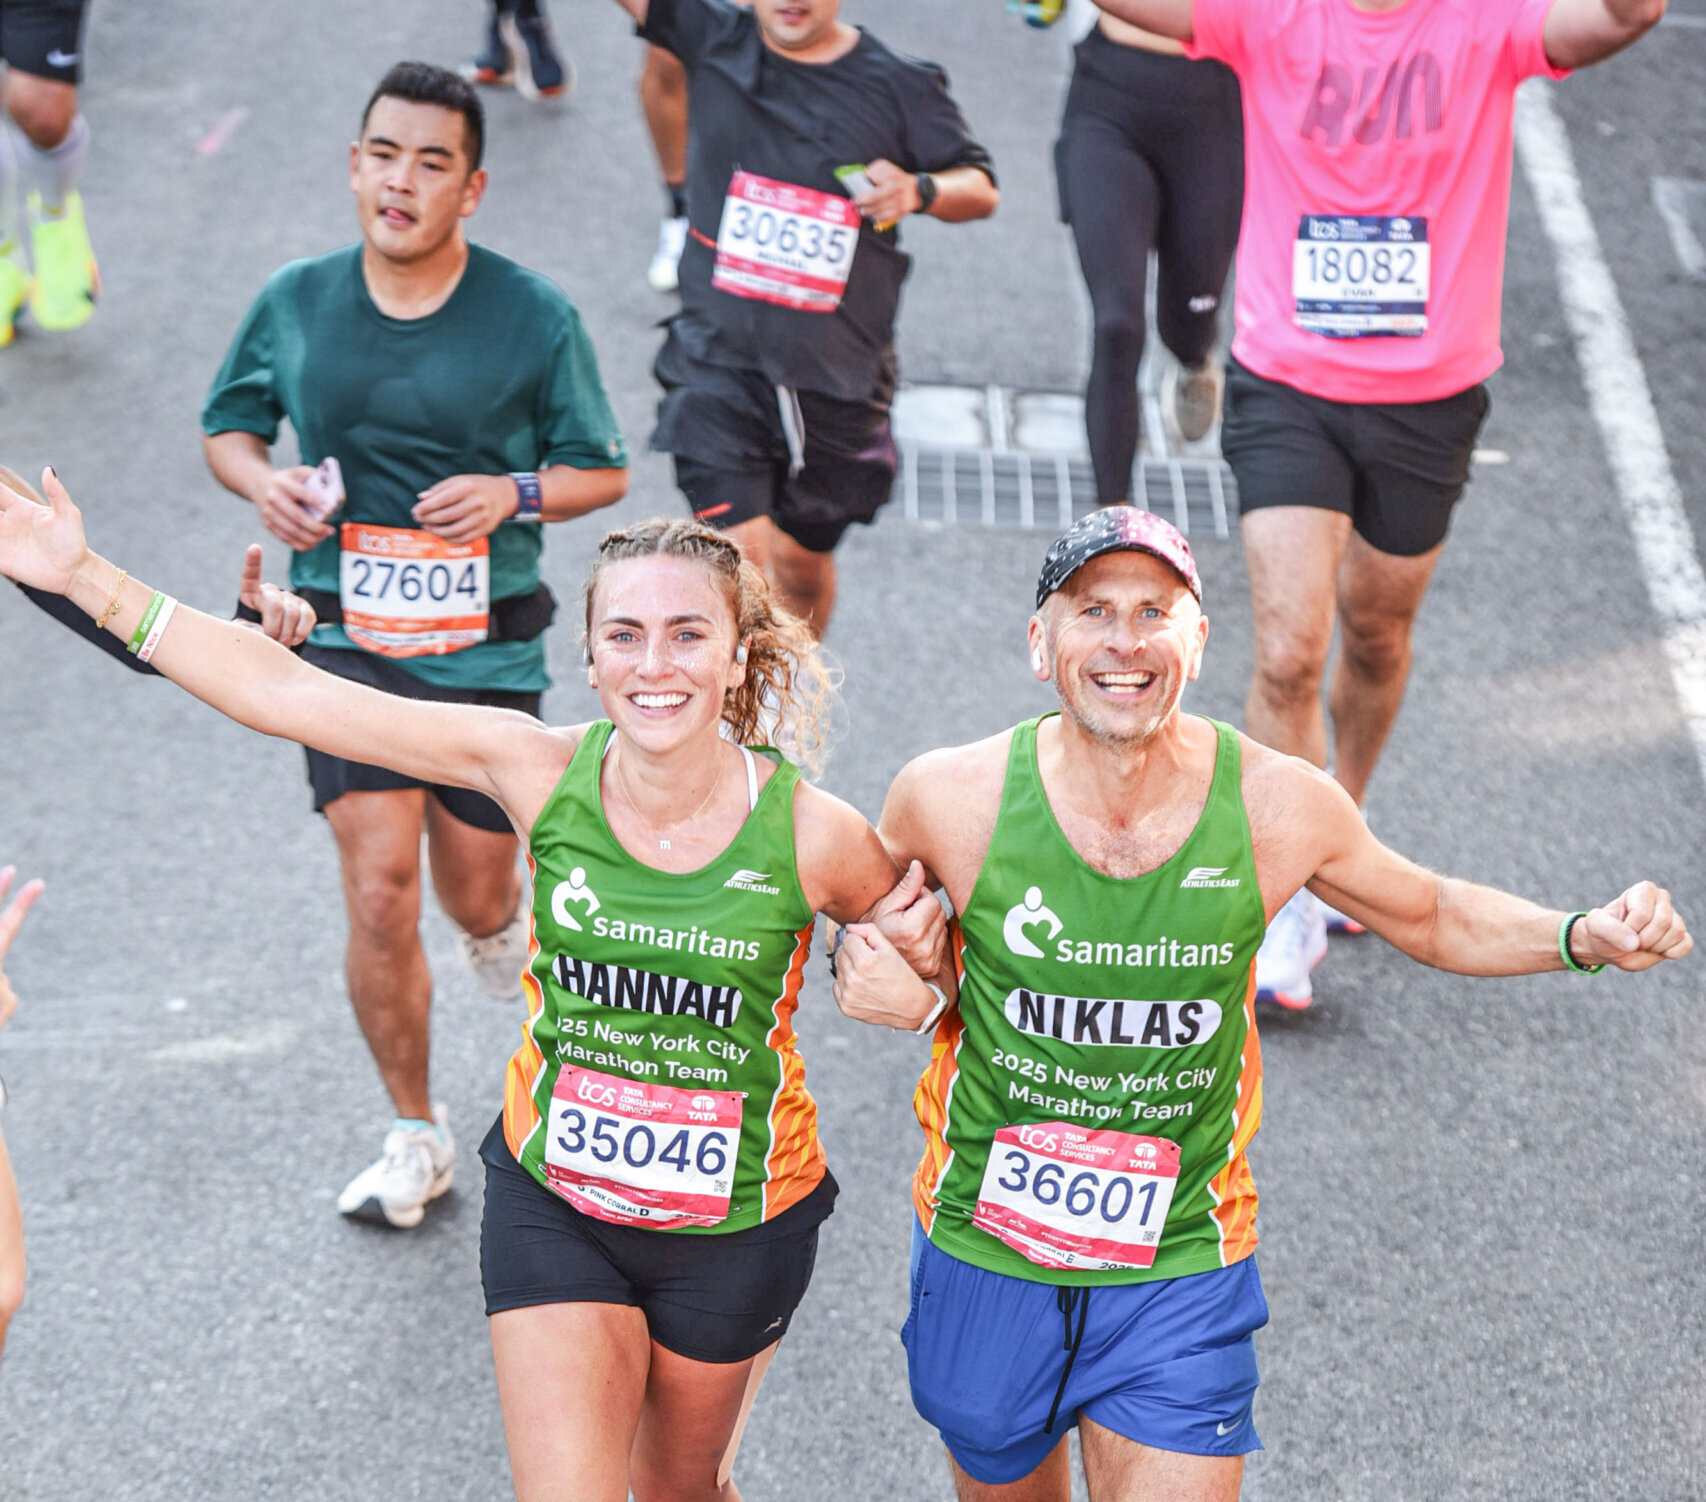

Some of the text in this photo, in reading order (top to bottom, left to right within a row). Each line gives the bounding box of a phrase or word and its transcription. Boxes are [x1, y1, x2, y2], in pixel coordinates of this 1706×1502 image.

[1300, 50, 1442, 146] RUN
[730, 205, 848, 264] 30635
[1308, 247, 1416, 284] 18082
[353, 559, 478, 601] 27604
[592, 916, 761, 961] samaritans
[1056, 936, 1234, 967] samaritans
[558, 952, 740, 1028] HANNAH
[1017, 989, 1203, 1047] NIKLAS
[557, 1015, 751, 1065] 25 New York City
[557, 1040, 728, 1083] Marathon Team
[991, 1048, 1217, 1093] 2025 New York City
[577, 1075, 618, 1107] tcs
[620, 1094, 673, 1110] CONSULTANCY
[623, 1086, 644, 1098] TATA
[1008, 1081, 1193, 1120] Marathon Team
[617, 1103, 653, 1116] SERVICES
[688, 1111, 718, 1122] TATA
[557, 1108, 728, 1175] 35046
[1019, 1124, 1060, 1152] tcs
[1061, 1140, 1116, 1156] CONSULTANCY
[1064, 1132, 1087, 1142] TATA
[1059, 1149, 1095, 1162] SERVICES
[1129, 1159, 1157, 1170] TATA
[590, 1188, 607, 1202] PINK
[607, 1198, 637, 1214] CORRAL
[639, 1208, 650, 1217] D
[998, 1151, 1158, 1226] 36601
[1066, 1253, 1076, 1264] E
